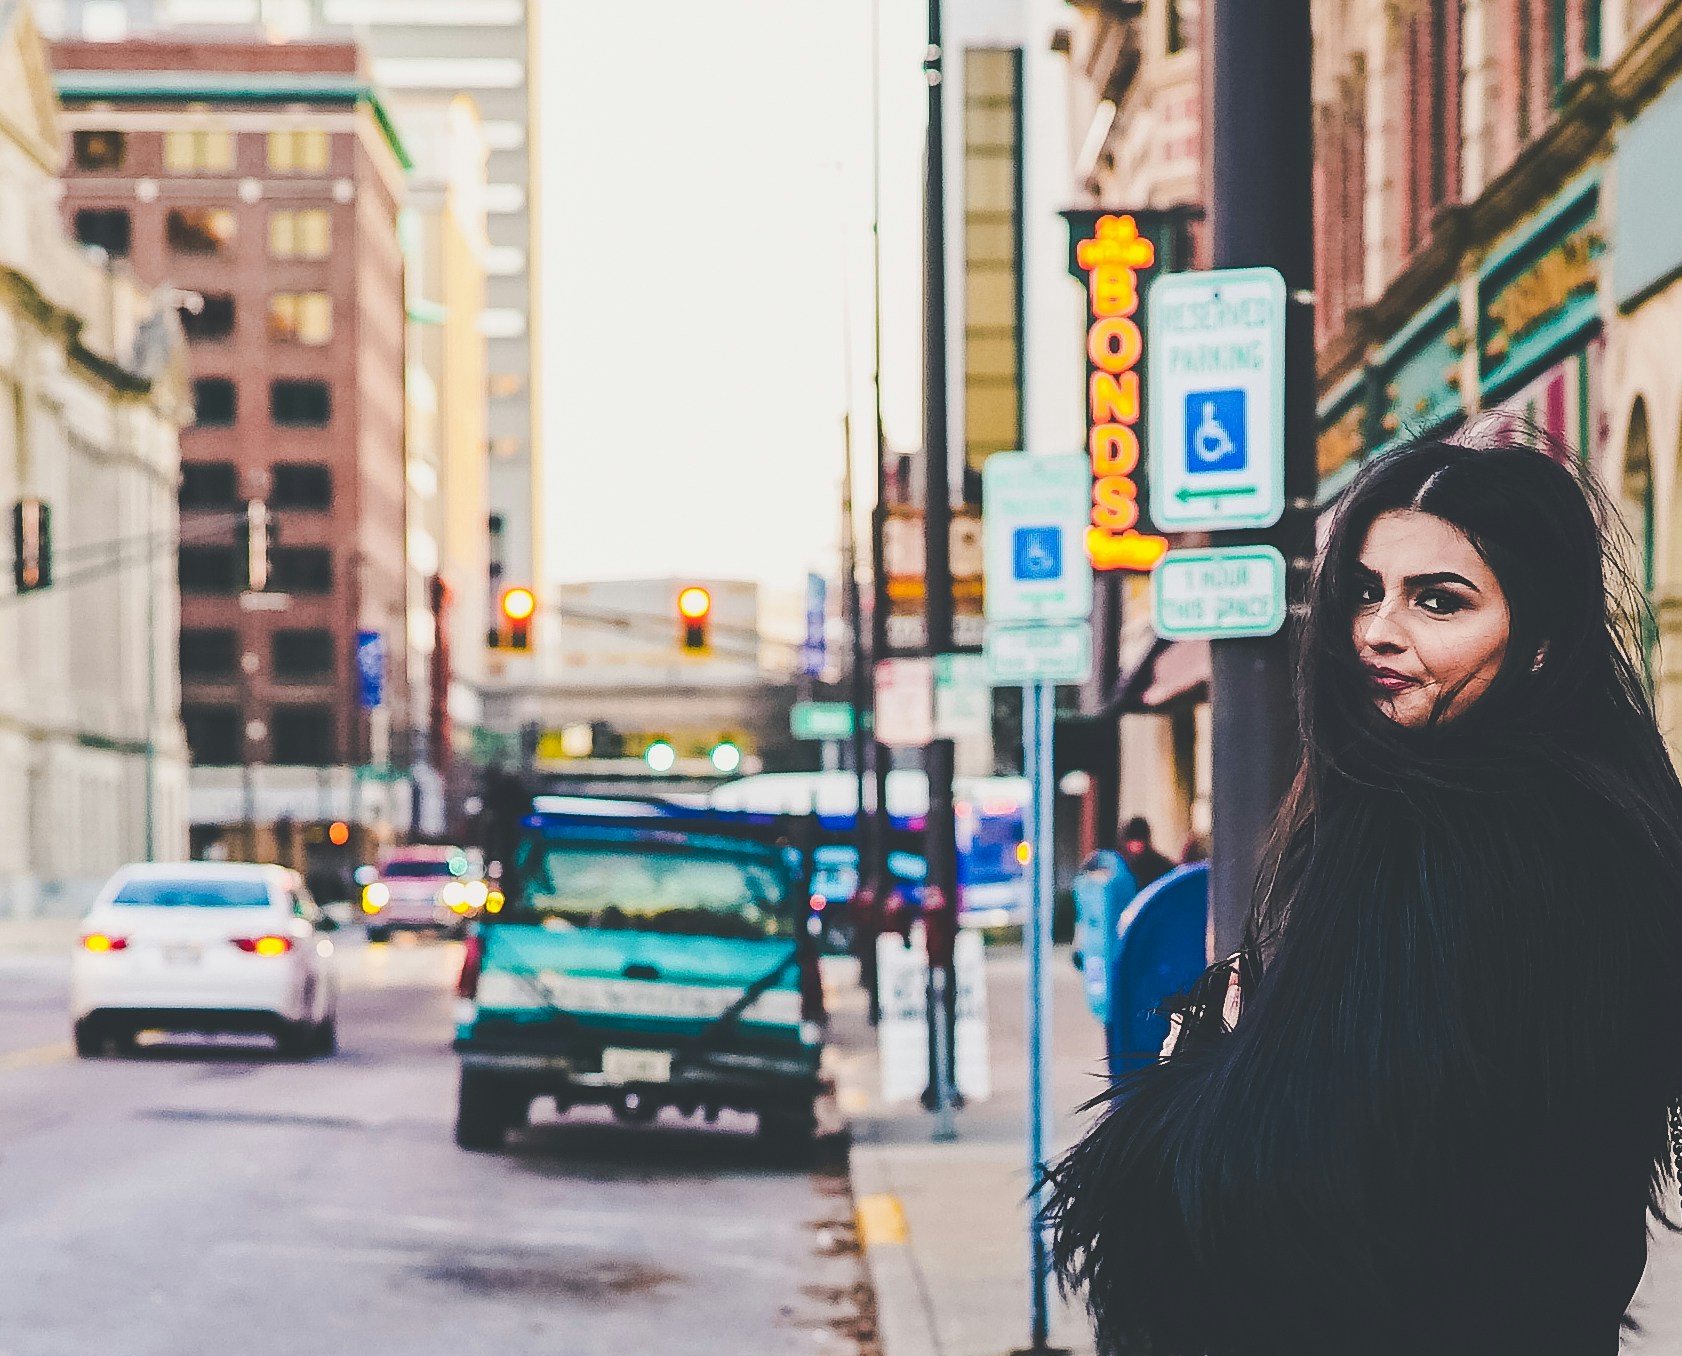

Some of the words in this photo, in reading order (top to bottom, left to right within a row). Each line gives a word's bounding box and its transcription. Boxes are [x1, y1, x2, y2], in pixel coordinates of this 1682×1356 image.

[1161, 298, 1272, 333] RESERVED
[1168, 340, 1263, 373] PARKING
[1089, 264, 1142, 530] BONDS
[1203, 564, 1248, 587] HOUR
